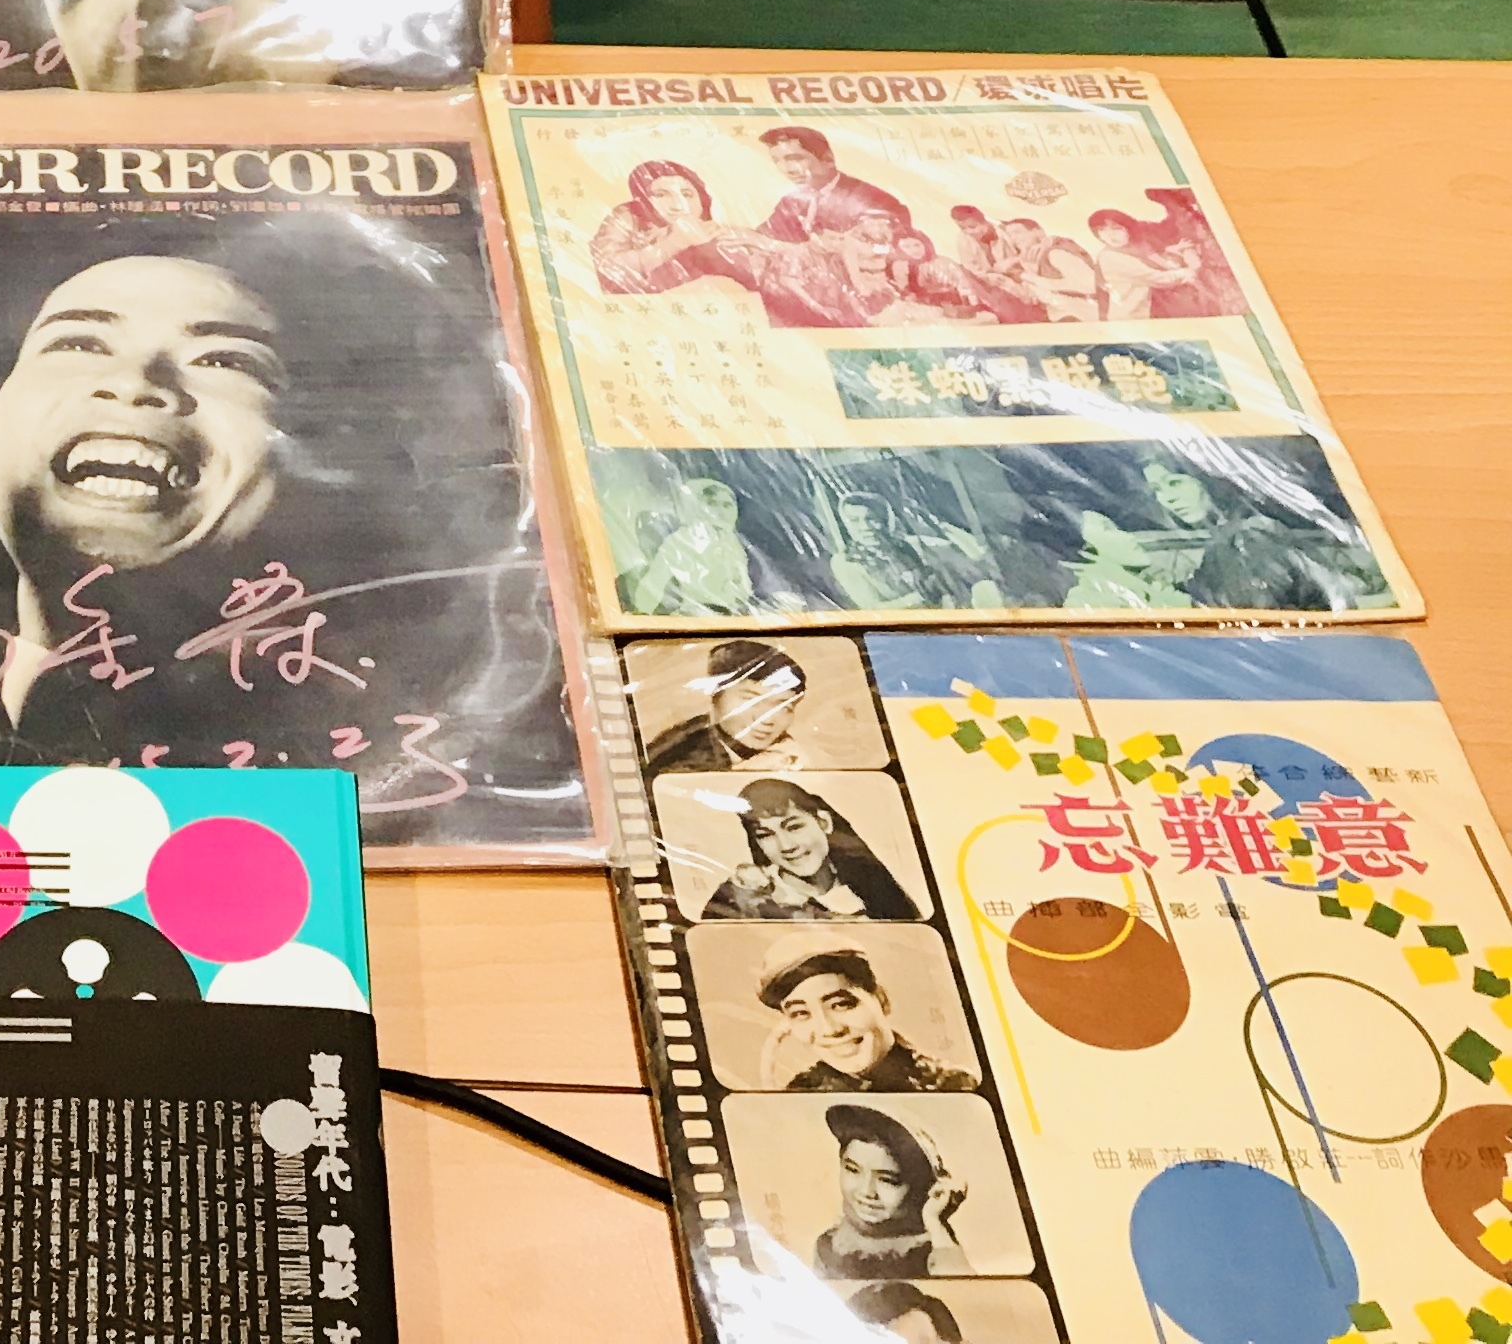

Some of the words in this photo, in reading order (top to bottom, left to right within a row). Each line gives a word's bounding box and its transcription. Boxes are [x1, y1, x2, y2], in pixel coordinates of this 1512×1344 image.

[502, 77, 754, 107] UNIVERSAL
[768, 75, 947, 105] RECORD
[97, 147, 458, 199] RECORD
